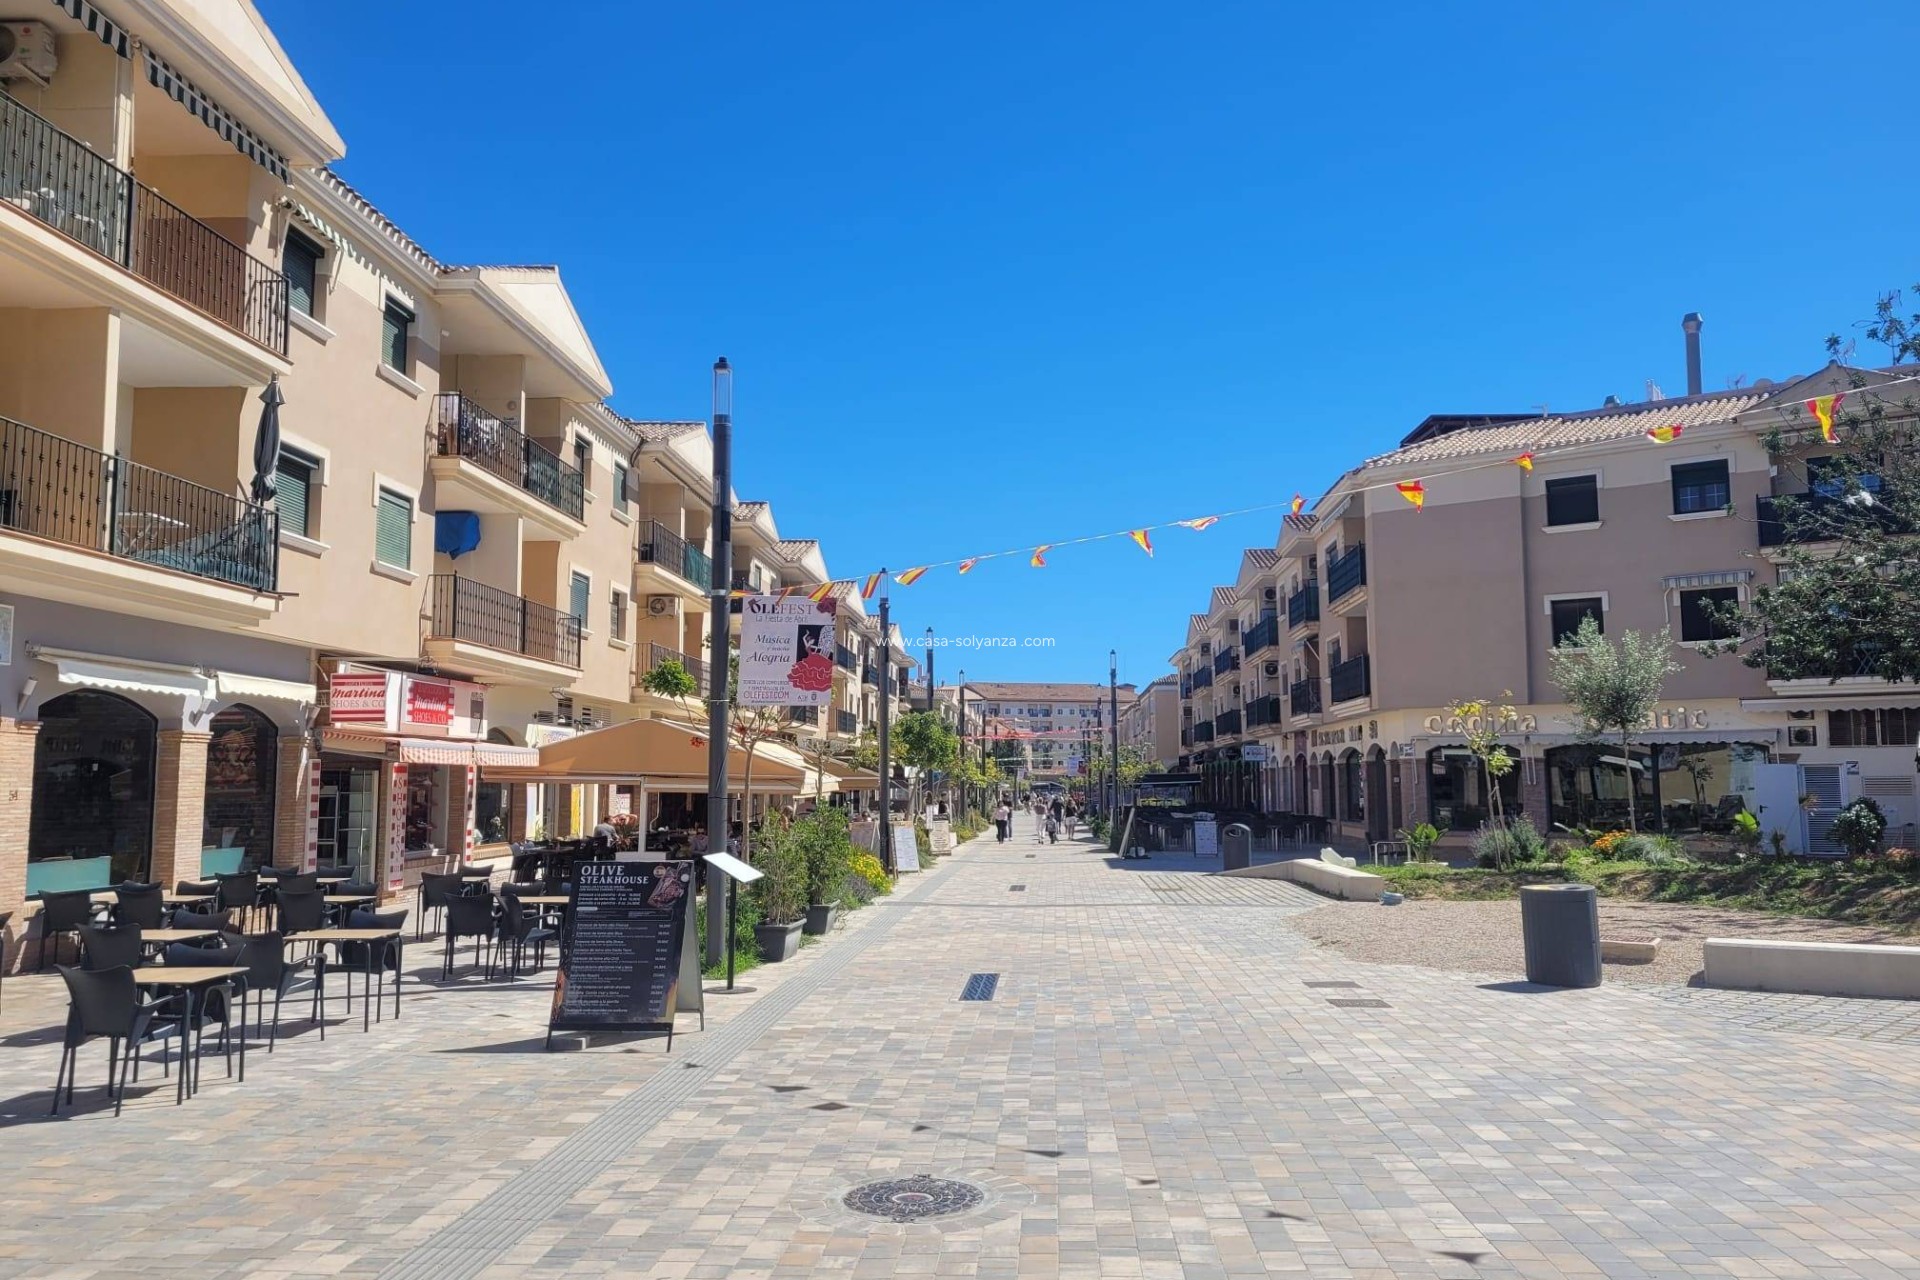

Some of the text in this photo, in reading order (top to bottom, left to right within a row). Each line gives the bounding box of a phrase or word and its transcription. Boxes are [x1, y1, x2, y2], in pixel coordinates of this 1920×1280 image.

[331, 699, 360, 708] SHOES
[371, 699, 386, 708] CO
[581, 865, 625, 876] OLIVE
[579, 876, 650, 884] STEAKHOUSE
